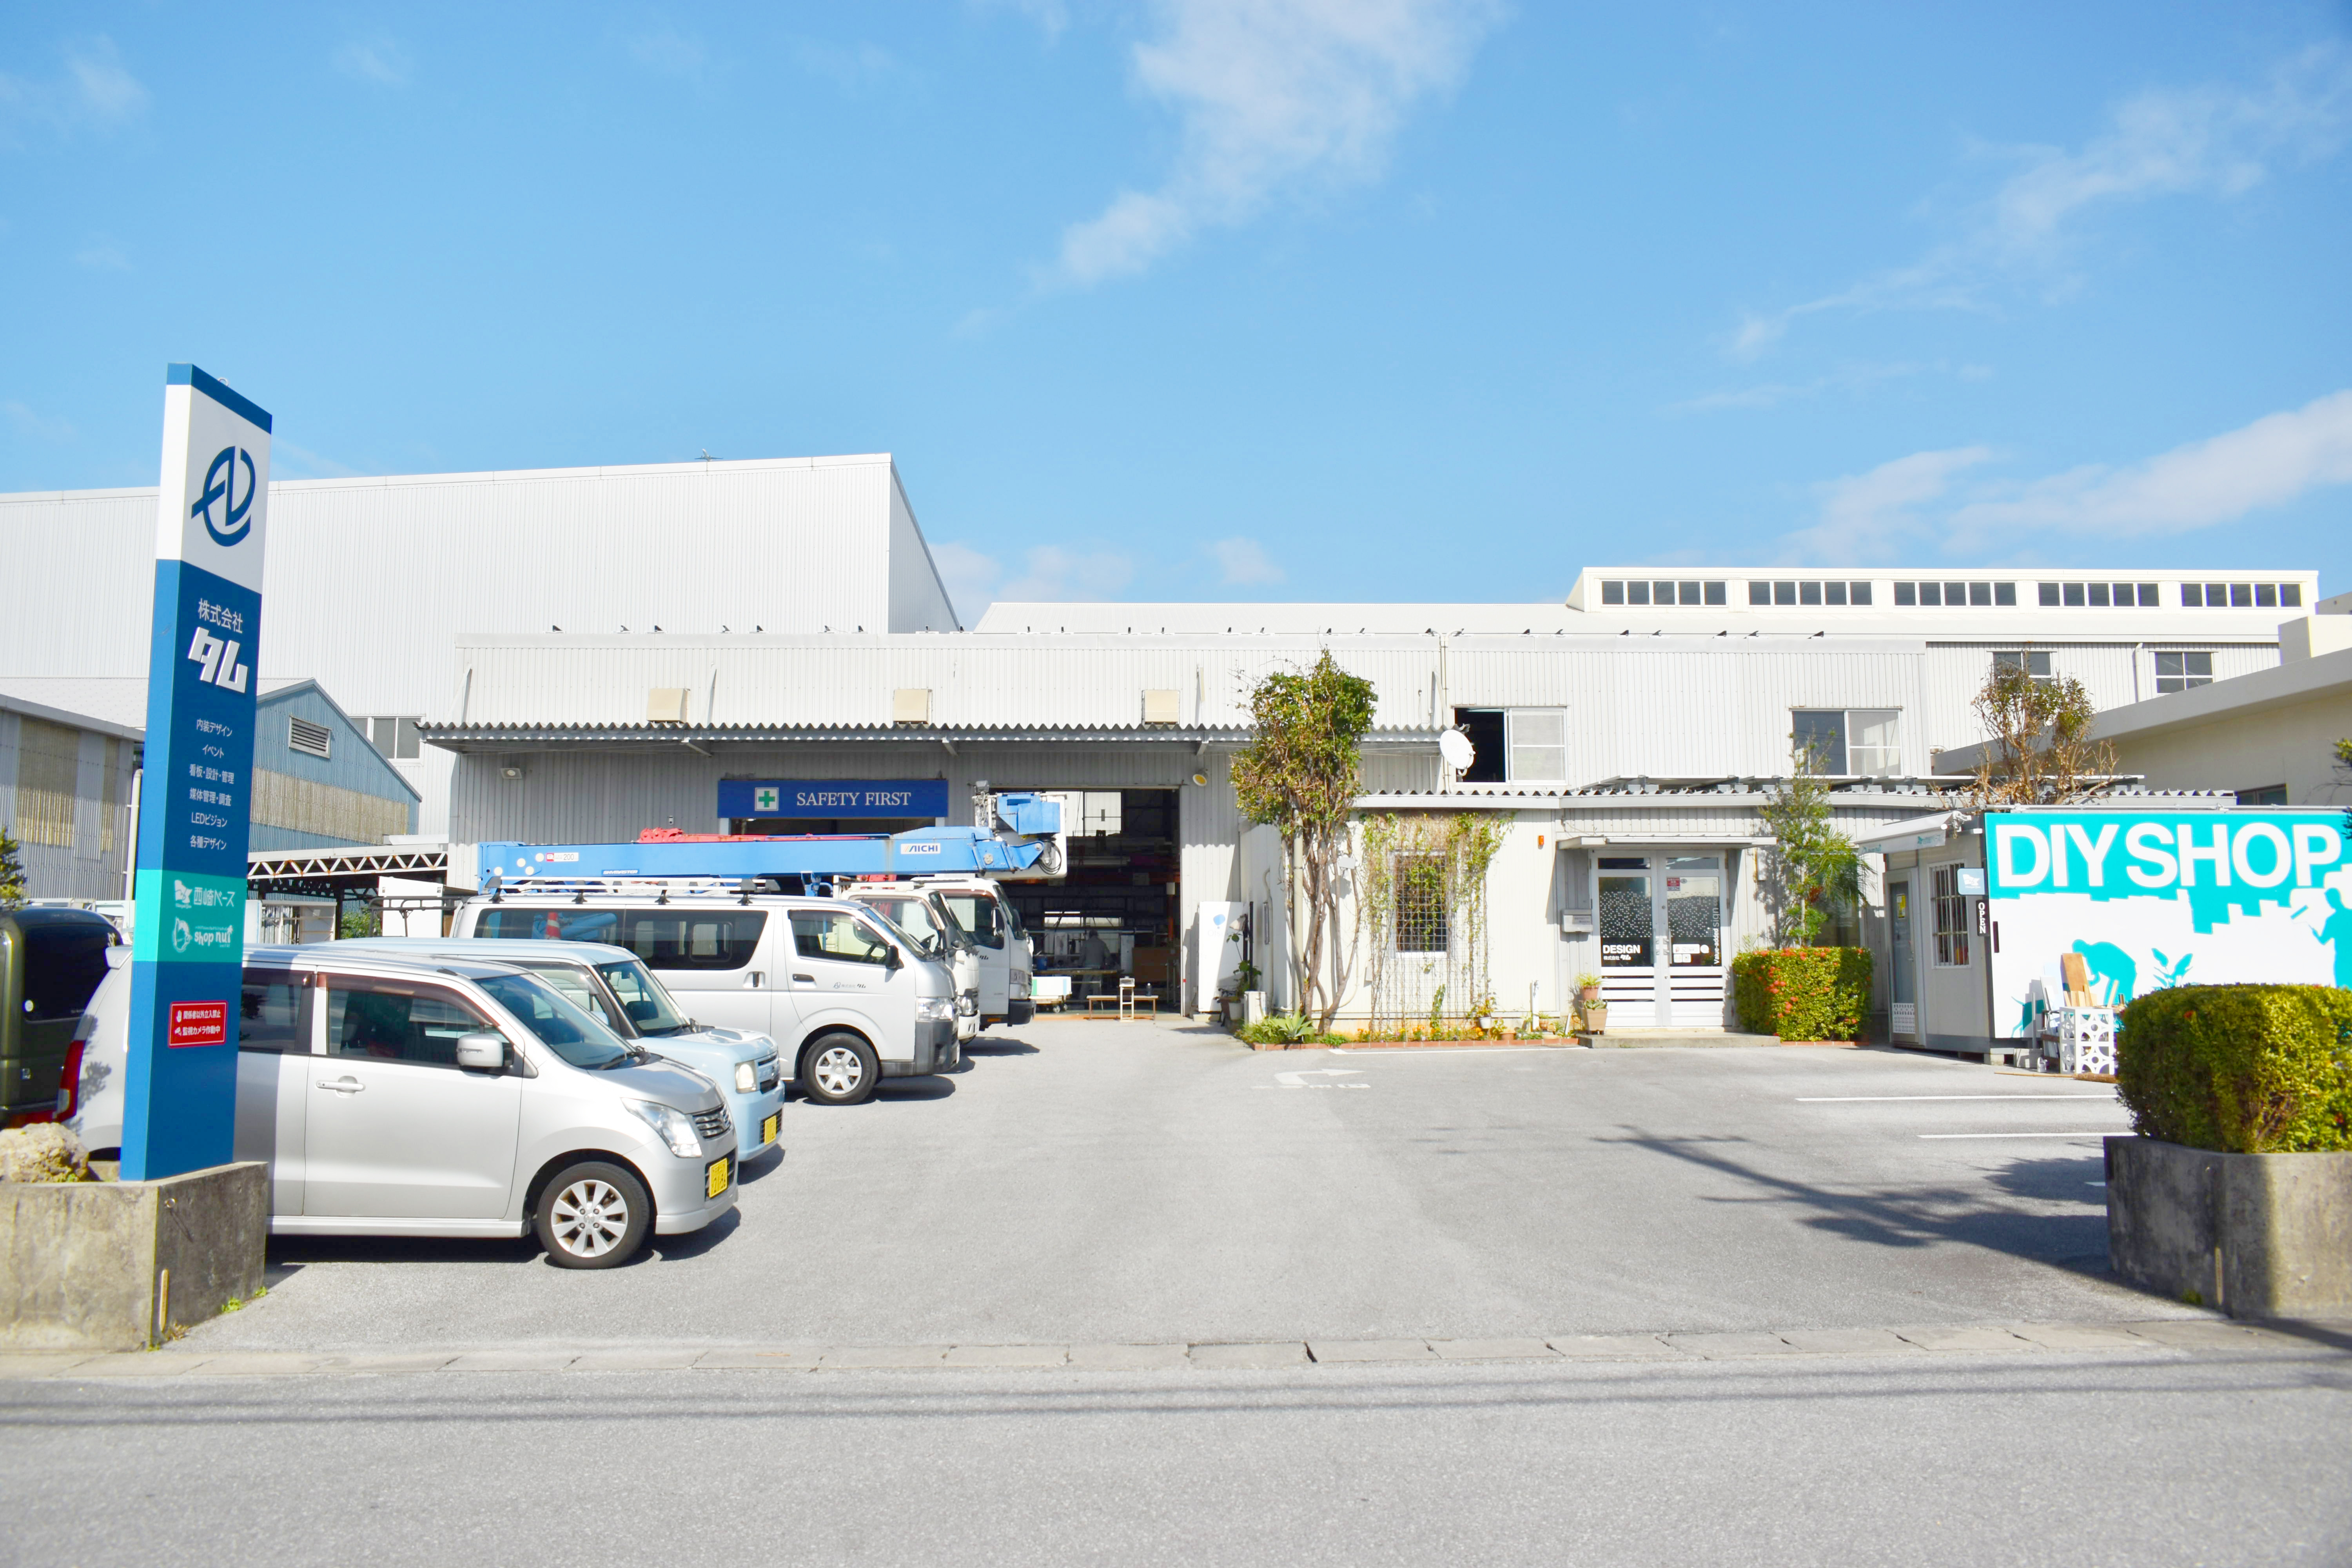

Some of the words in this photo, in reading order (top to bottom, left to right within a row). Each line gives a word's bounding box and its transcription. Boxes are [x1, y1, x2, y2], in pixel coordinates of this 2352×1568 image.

[198, 598, 243, 634] 株式会社
[188, 627, 248, 693] タム
[196, 719, 232, 737] 内装デザイン
[202, 744, 224, 759] イベント
[189, 764, 234, 784] 看板・設計・管理
[797, 792, 860, 806] SAFETY
[865, 792, 911, 806] FIRST
[191, 812, 227, 828] LEDビジョン
[190, 835, 227, 850] 各種デザイン
[1996, 823, 2119, 887] DIY
[2125, 822, 2342, 888] SHOP
[1978, 902, 1986, 934] OPEN
[1603, 944, 1641, 953] DESIGN
